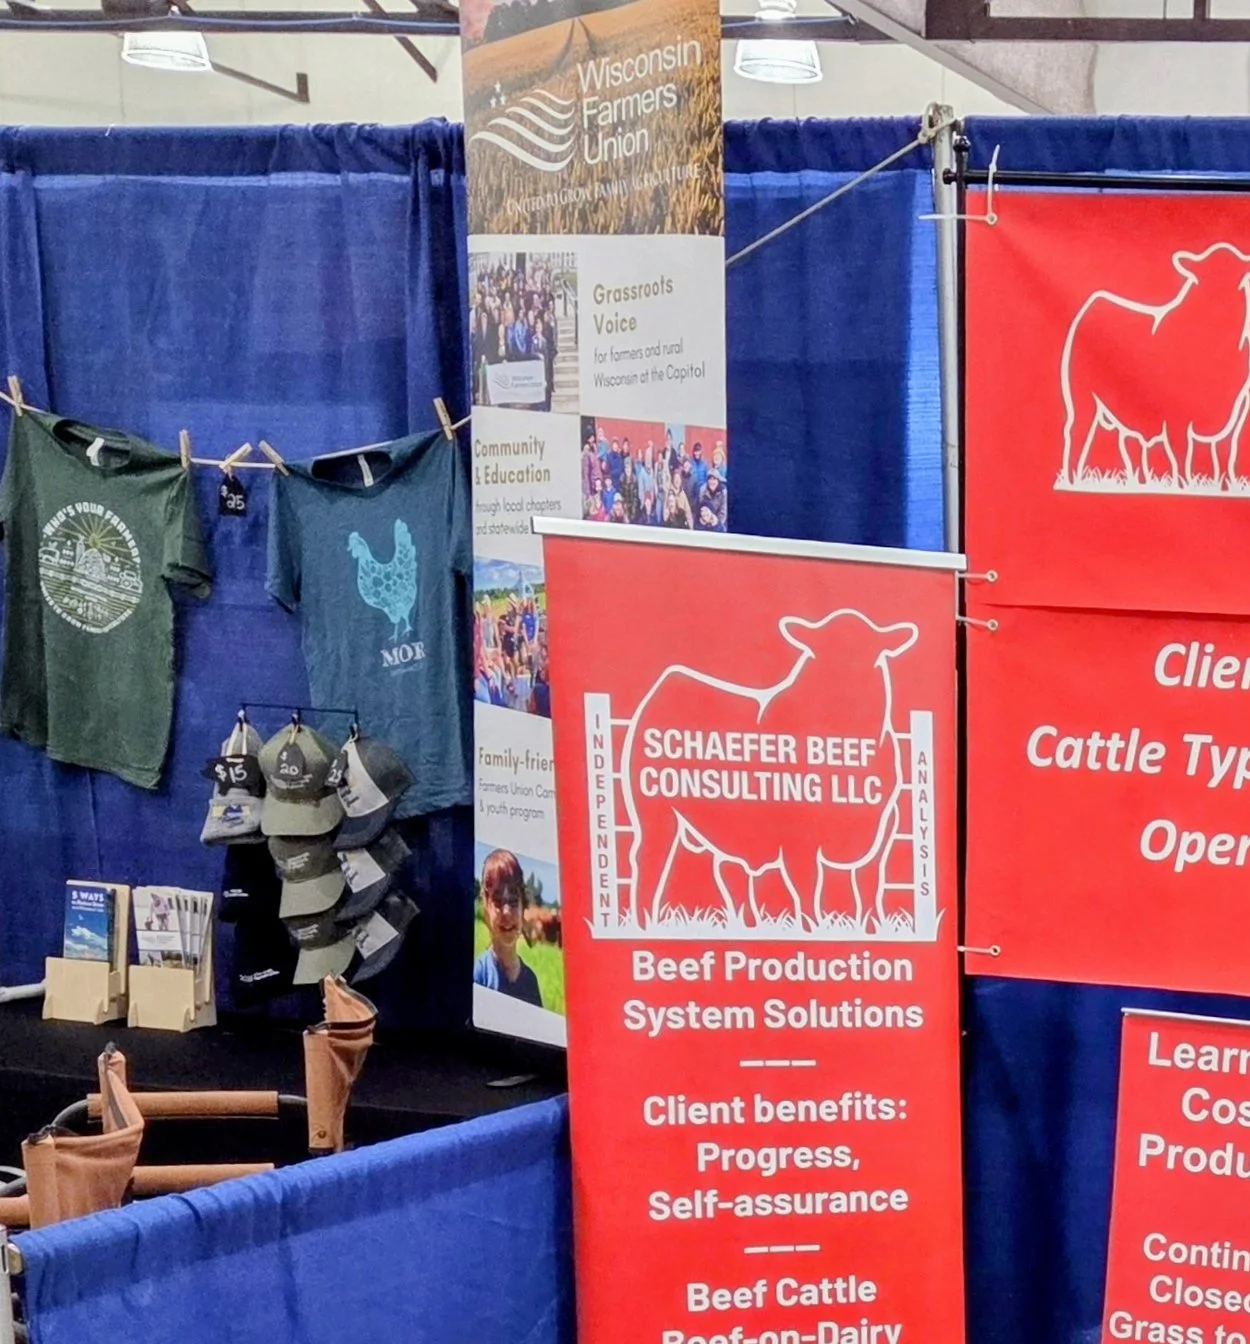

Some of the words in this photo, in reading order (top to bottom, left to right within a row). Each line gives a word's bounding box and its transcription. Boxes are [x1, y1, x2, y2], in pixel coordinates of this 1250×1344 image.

[576, 35, 700, 93] Wisconsin
[583, 82, 677, 129] Farmers
[584, 127, 648, 165] Union
[593, 275, 674, 306] Grassroots
[593, 313, 638, 335] Voice
[594, 371, 638, 388] Wisconsin
[666, 361, 705, 384] Capitol
[474, 435, 546, 461] Community
[484, 463, 551, 485] Education
[75, 501, 105, 517] YOUR
[643, 727, 798, 764] SCHAEFER
[807, 736, 876, 767] BEEF
[1026, 724, 1166, 774] Cattle
[214, 764, 248, 784] $15
[640, 767, 822, 803] CONSULTING
[831, 774, 882, 805] LLC
[595, 713, 611, 929] INDEPENDENT
[916, 751, 930, 897] ANALYSIS
[632, 950, 716, 981] Beef
[724, 951, 913, 981] Production
[623, 999, 756, 1037] System
[763, 998, 923, 1029] Solutions
[643, 1094, 746, 1127] Client
[754, 1091, 908, 1124] benefits:
[697, 1141, 860, 1176] Progress,
[648, 1187, 910, 1221] Self-assurance
[686, 1280, 767, 1312] Beef
[776, 1275, 877, 1308] Cattle
